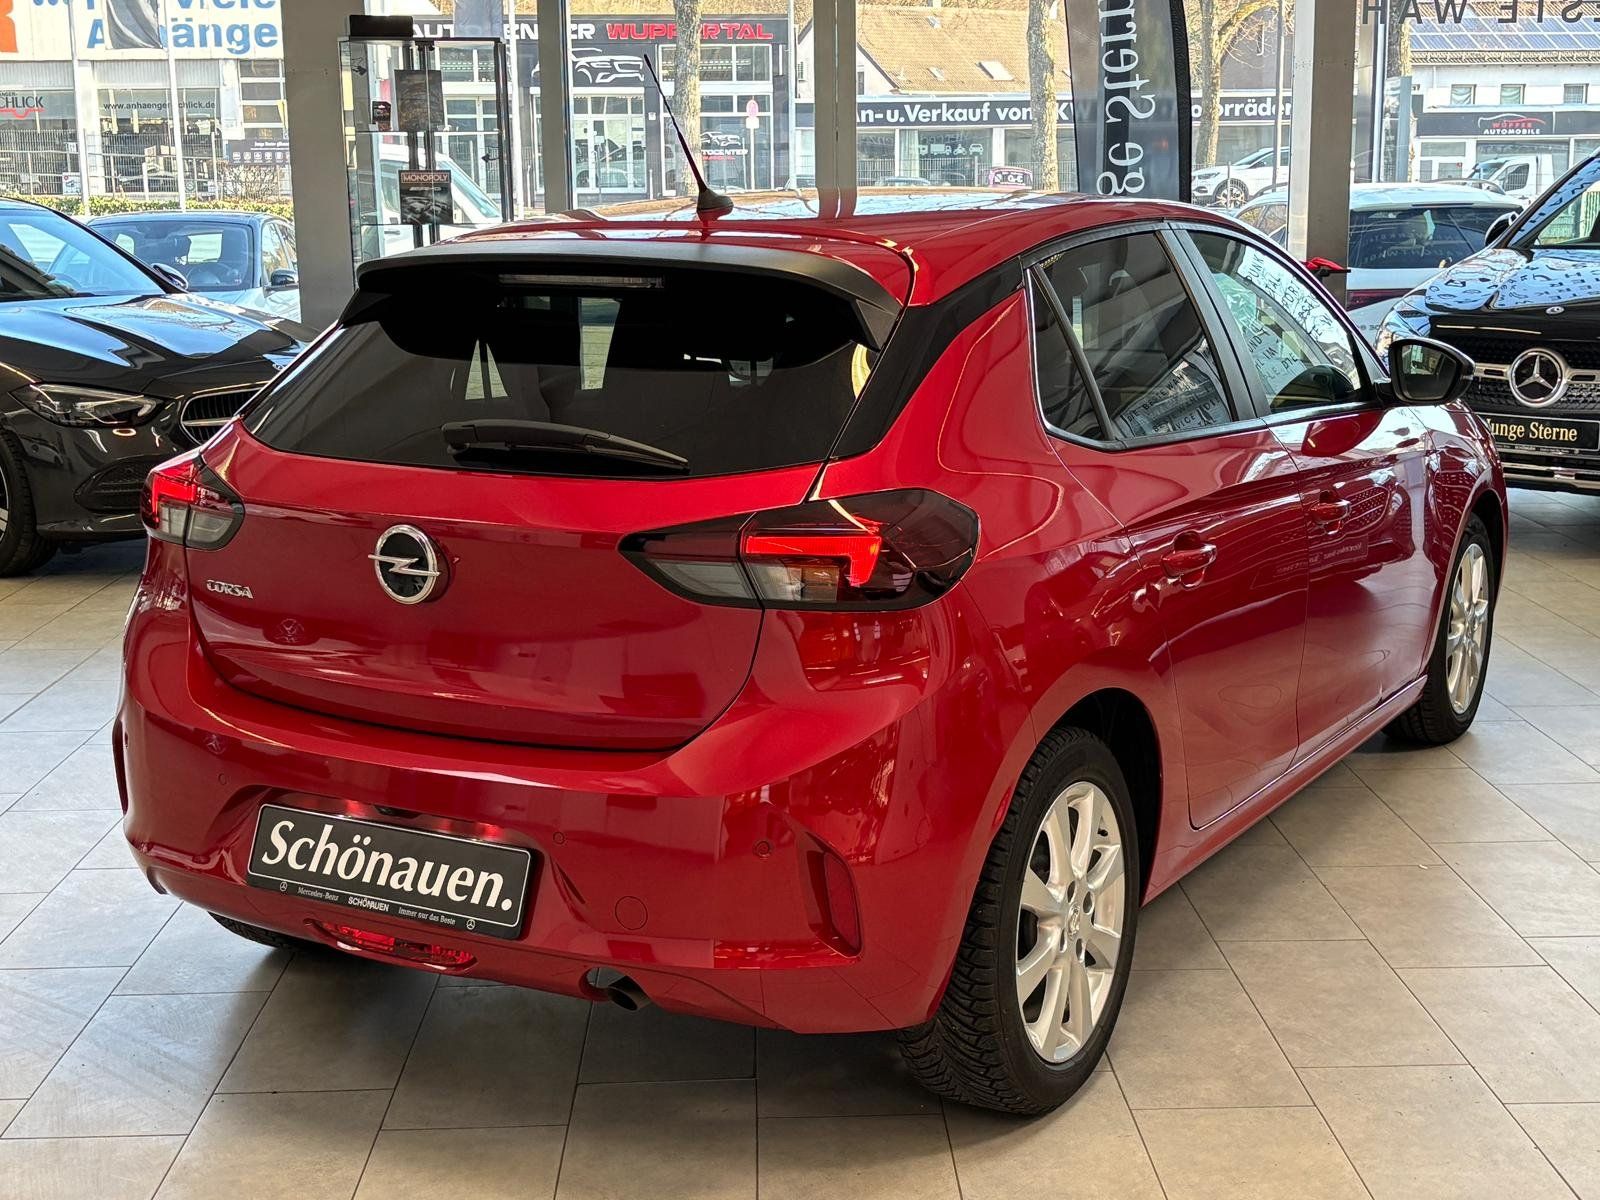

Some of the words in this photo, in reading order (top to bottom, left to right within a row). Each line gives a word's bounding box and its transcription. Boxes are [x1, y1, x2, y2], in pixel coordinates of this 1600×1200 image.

[606, 23, 774, 40] WUPPRTAL
[403, 173, 449, 182] MONOPOLY
[1529, 421, 1578, 442] Sterne
[206, 579, 254, 599] CORSA
[261, 820, 513, 911] Schönauen.
[348, 896, 390, 912] SCHÖNAUEN
[398, 906, 418, 918] Immer
[429, 912, 440, 922] das
[440, 915, 456, 926] Beste
